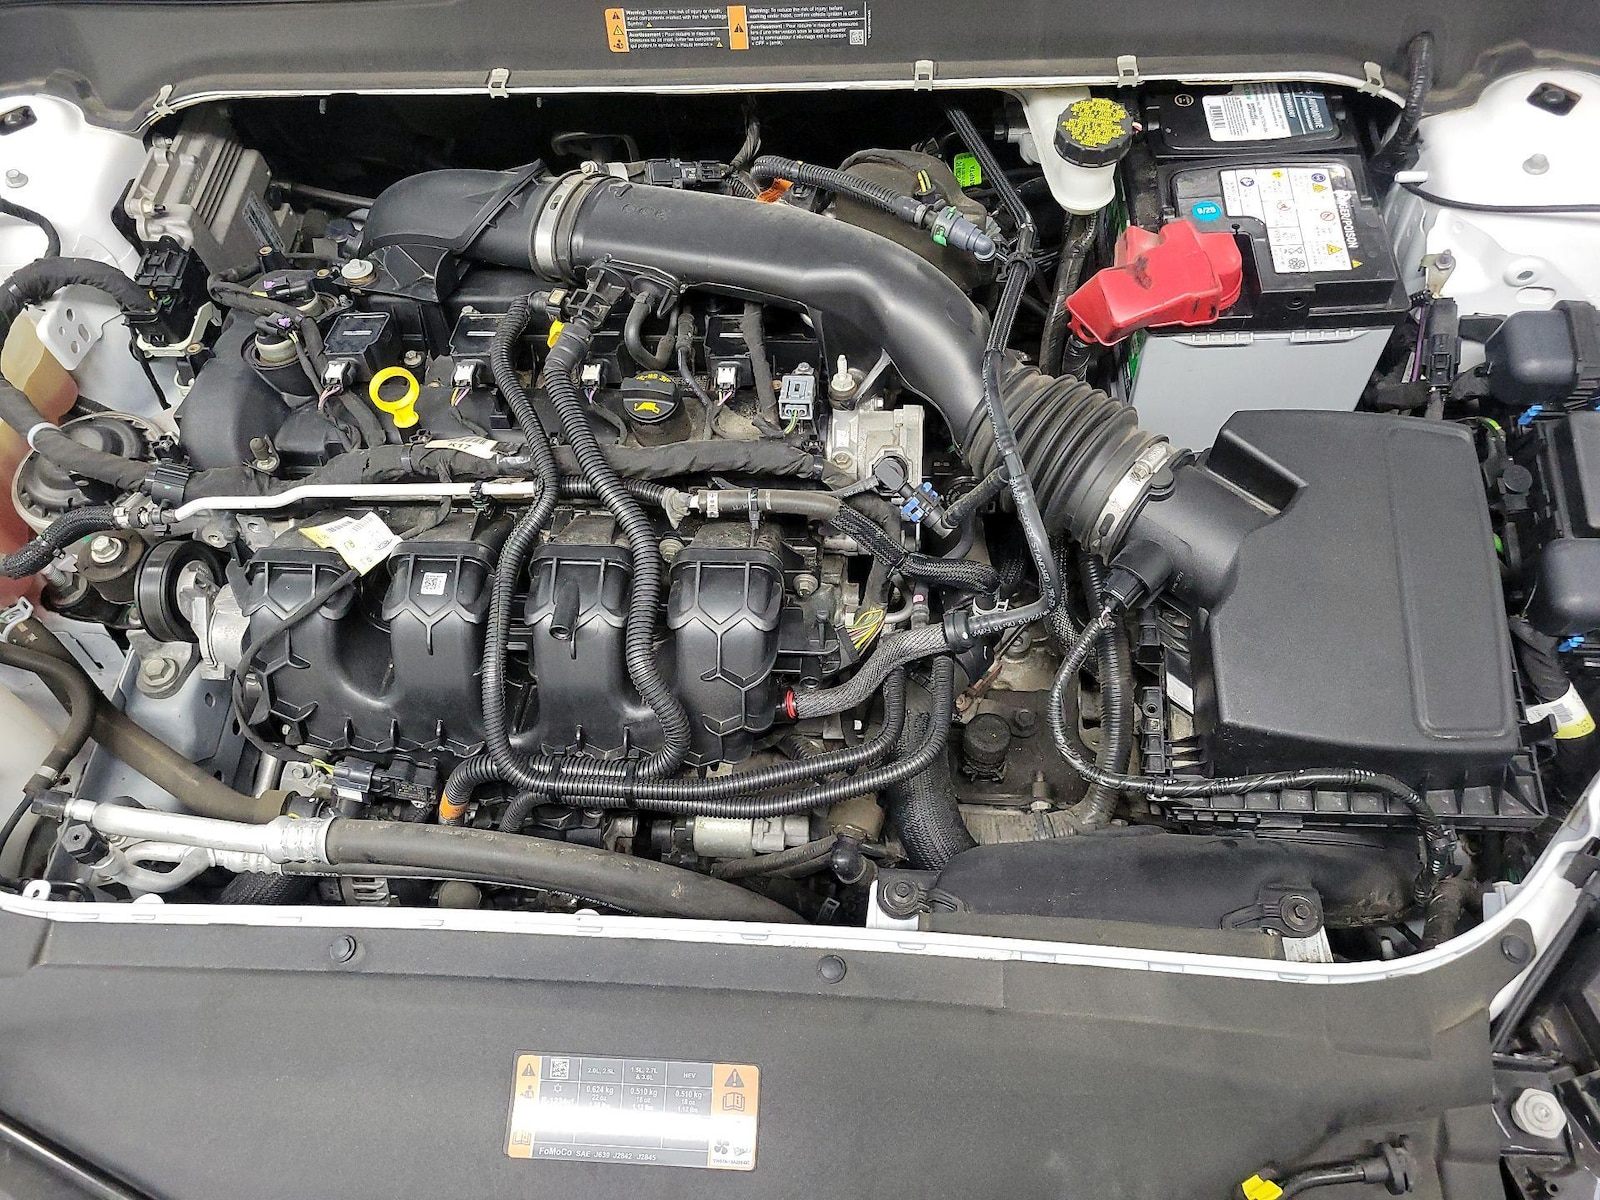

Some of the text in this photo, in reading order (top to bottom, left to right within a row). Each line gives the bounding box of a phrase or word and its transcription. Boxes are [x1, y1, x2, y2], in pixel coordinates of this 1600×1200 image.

[606, 1086, 614, 1095] kg
[649, 1088, 658, 1097] kg
[694, 1090, 702, 1099] kg
[539, 1147, 572, 1156] FoMoCo
